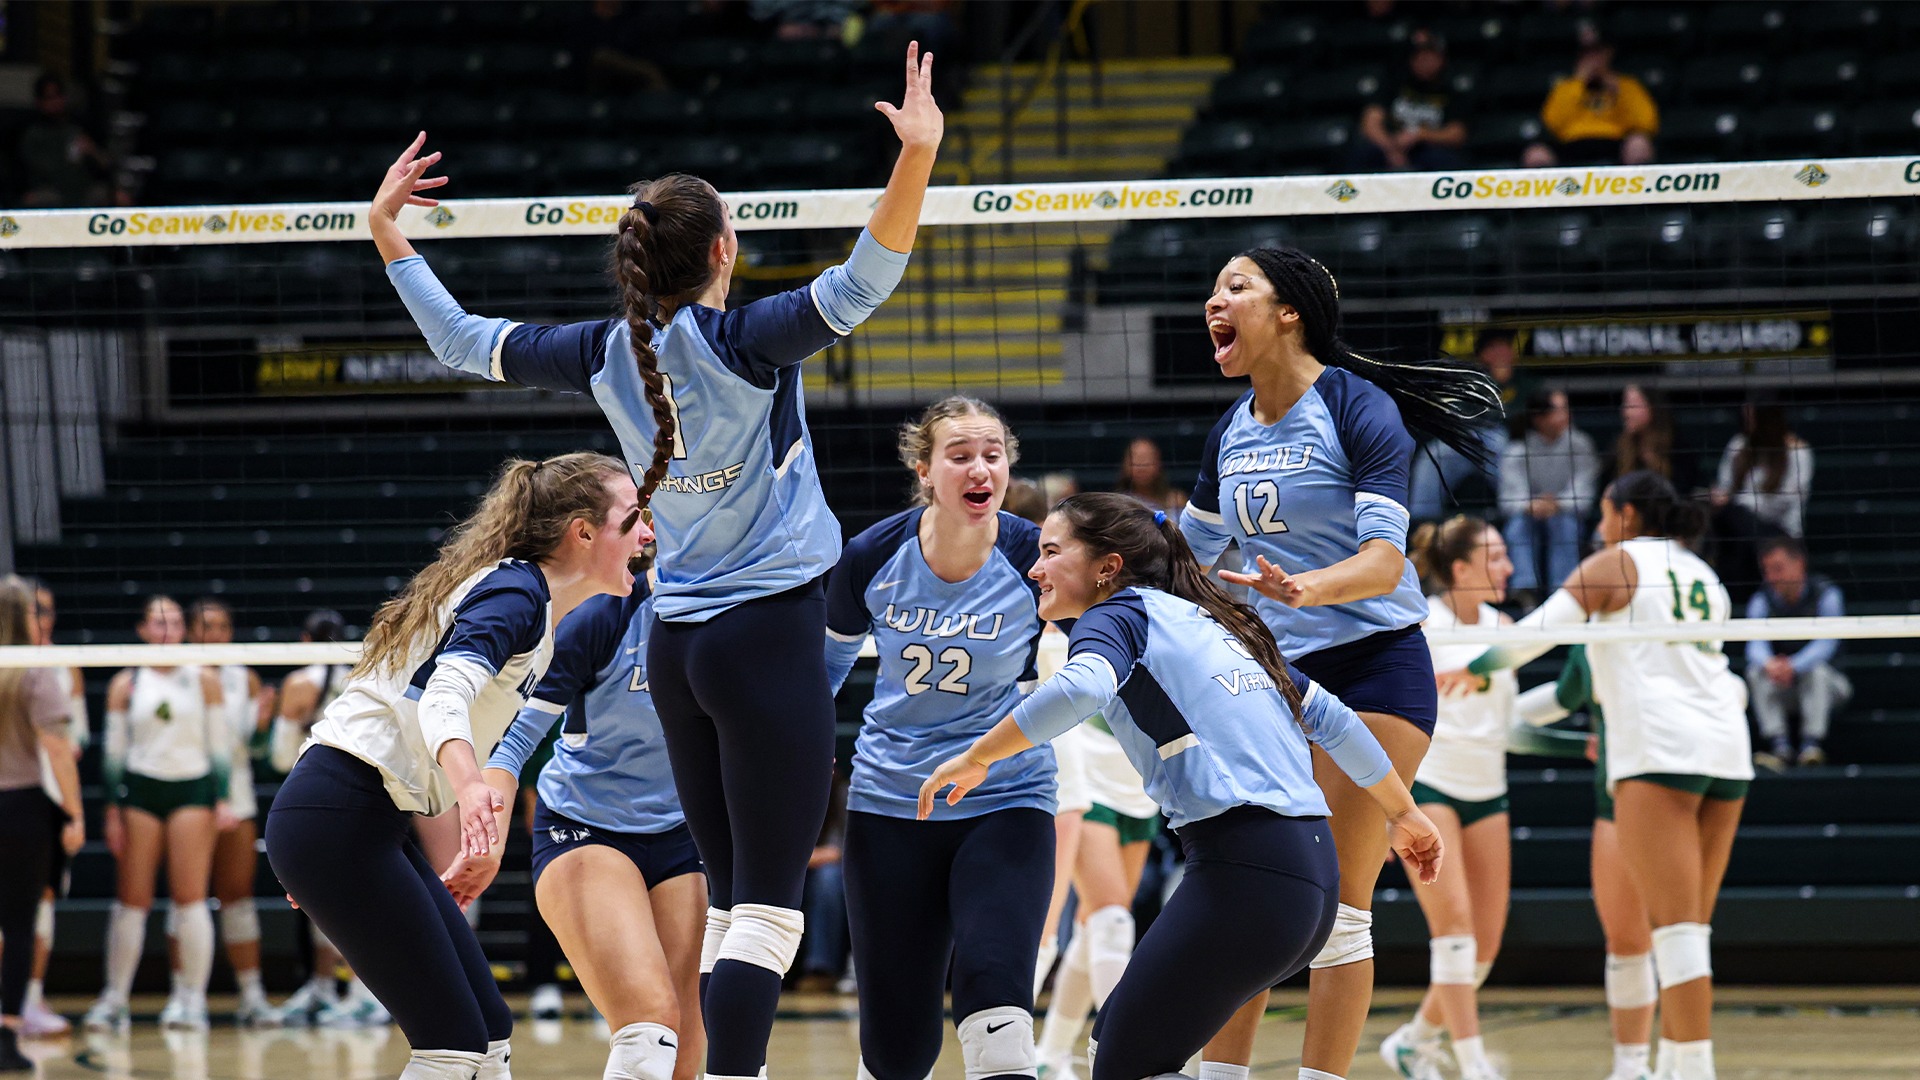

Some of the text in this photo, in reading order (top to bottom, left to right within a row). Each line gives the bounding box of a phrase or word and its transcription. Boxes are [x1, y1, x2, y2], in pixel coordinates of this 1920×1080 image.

[525, 201, 798, 225] GoSea.com
[1233, 479, 1290, 537] 12
[885, 603, 1004, 641] WWU
[901, 643, 973, 697] 22
